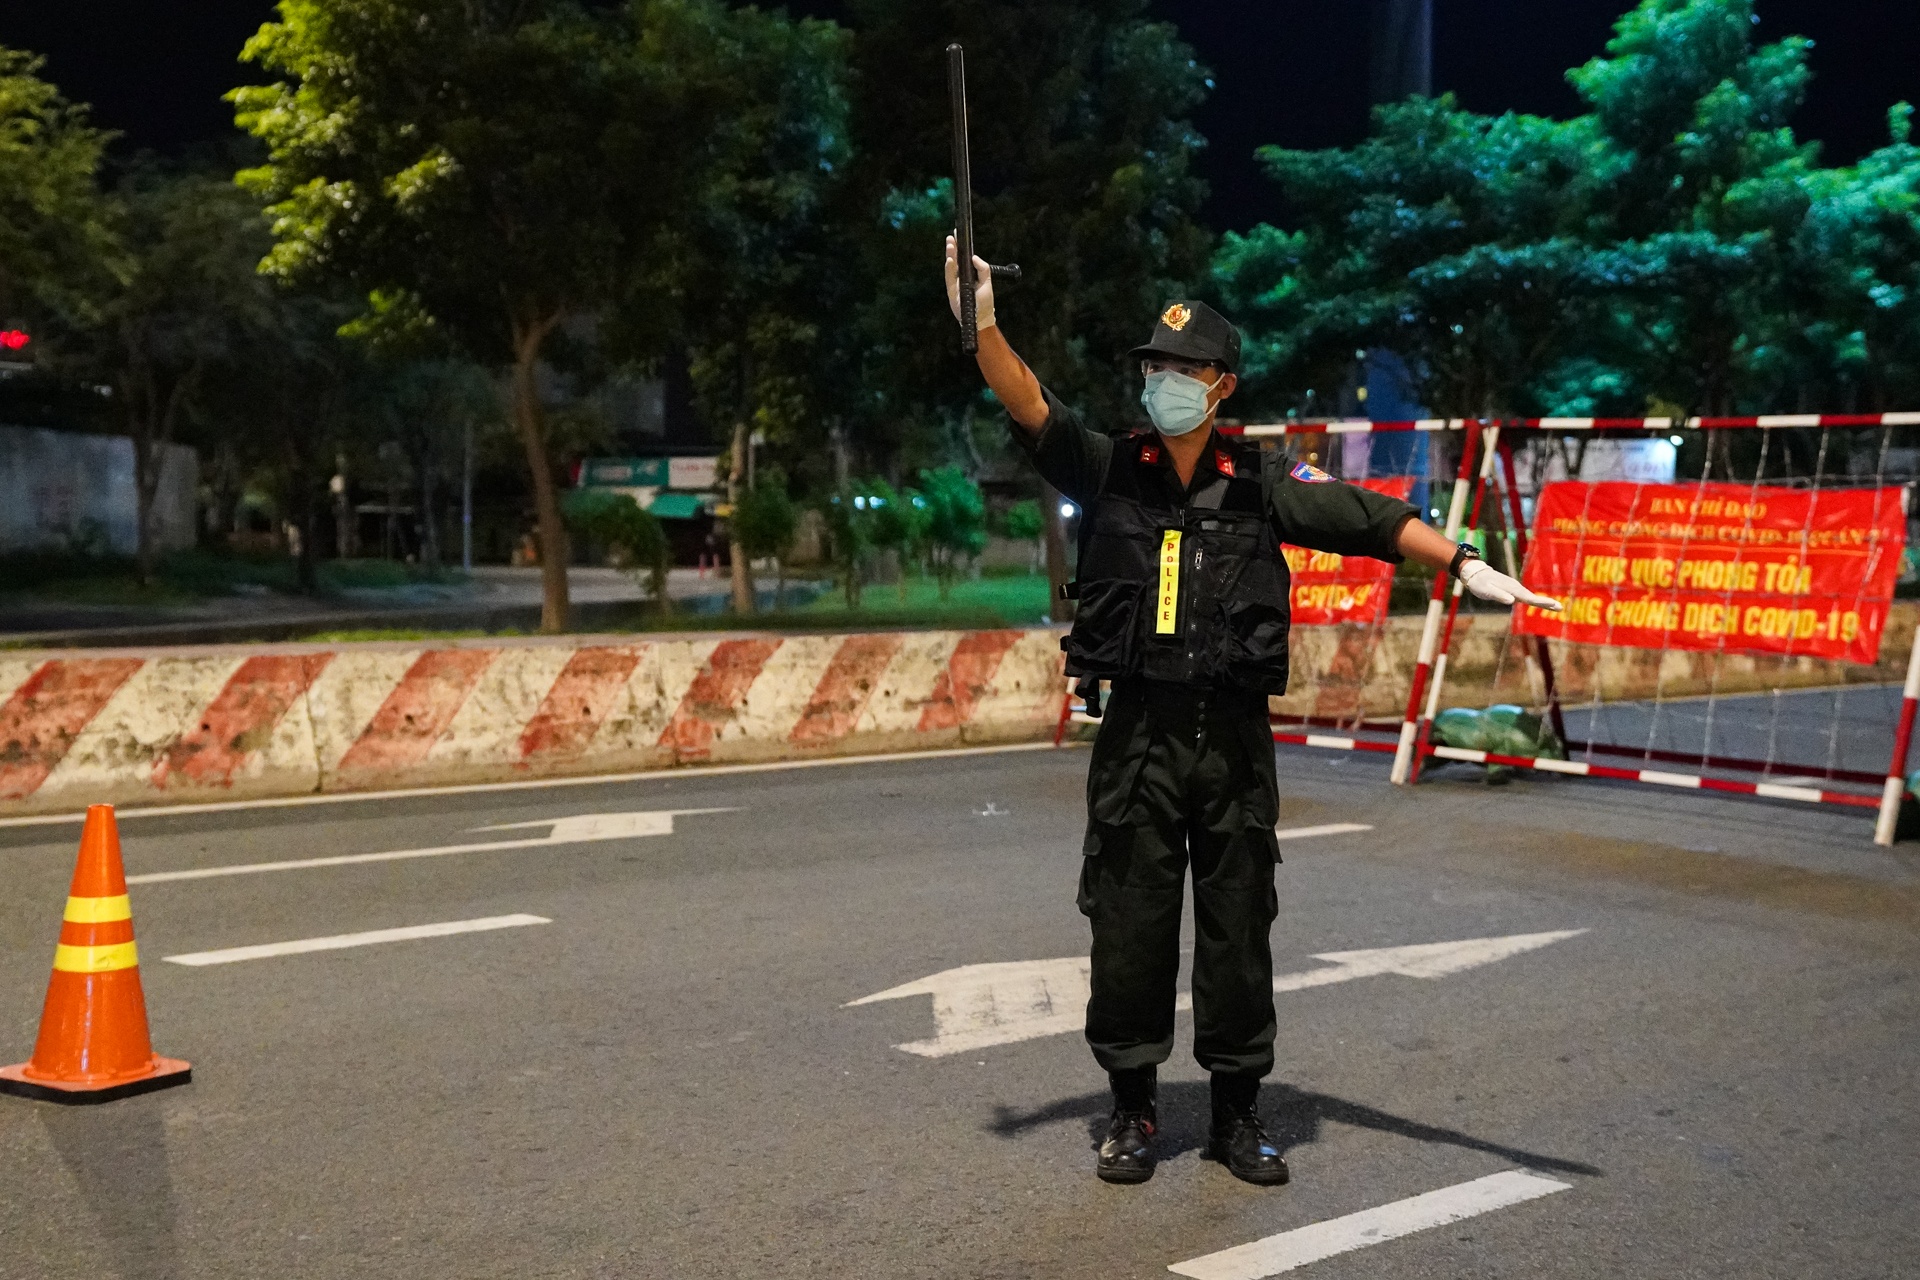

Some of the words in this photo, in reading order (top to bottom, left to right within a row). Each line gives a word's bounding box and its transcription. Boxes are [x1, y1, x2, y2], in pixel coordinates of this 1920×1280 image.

[1163, 541, 1176, 621] POLICE
[1582, 554, 1628, 585] KHU
[1677, 559, 1759, 592] PHONG
[1764, 554, 1813, 595] TỎA
[1605, 588, 1681, 631] CHỐNG
[1682, 602, 1741, 639] DỊCH
[1742, 605, 1861, 643] COVID-19
